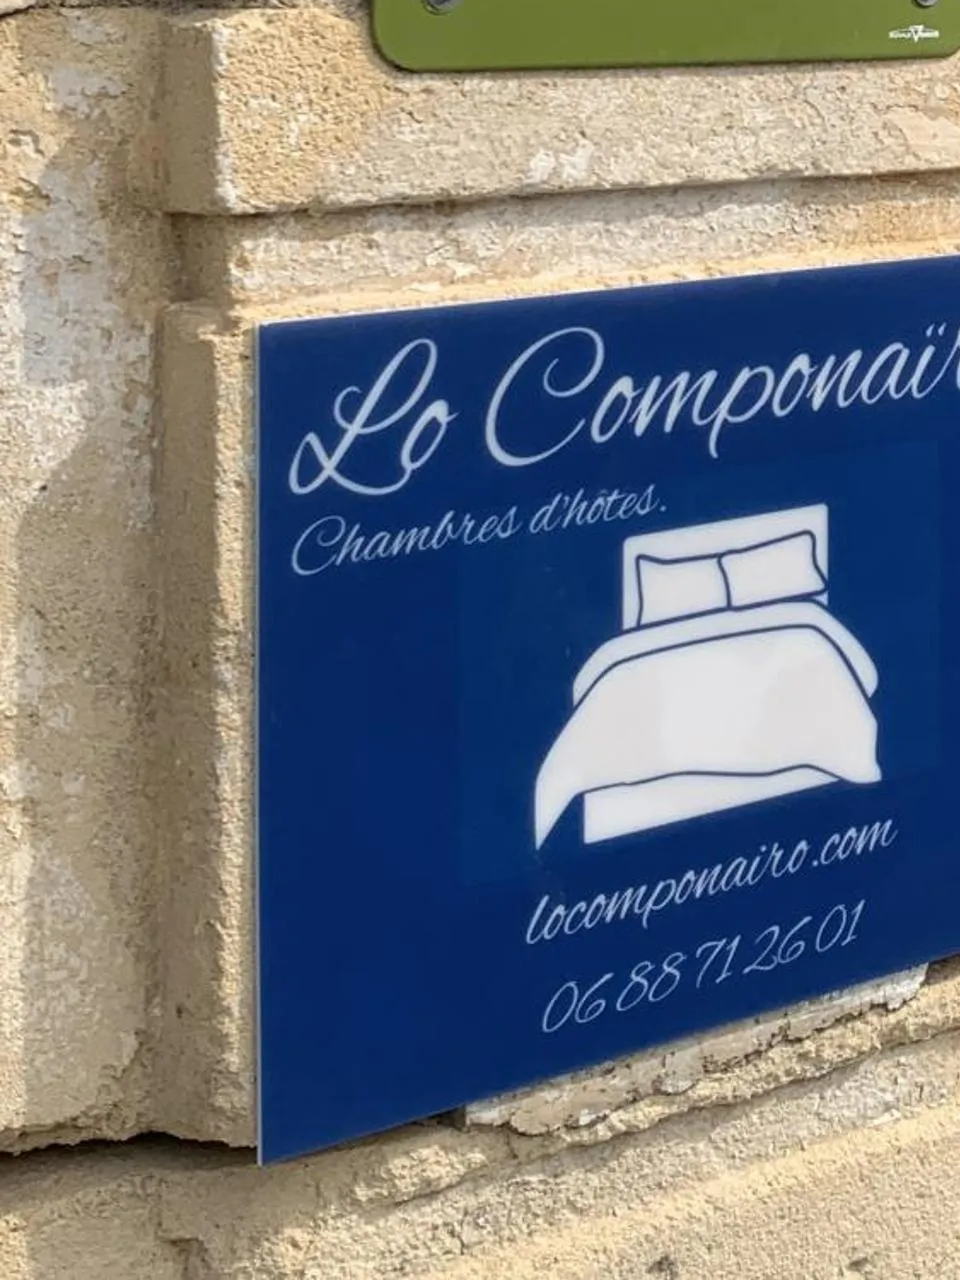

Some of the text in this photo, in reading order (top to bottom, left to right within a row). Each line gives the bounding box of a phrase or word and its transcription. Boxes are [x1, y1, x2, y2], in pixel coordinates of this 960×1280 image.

[288, 337, 457, 495] Lo
[290, 505, 522, 577] Chambres
[526, 819, 898, 944] locomponairo.com
[542, 899, 865, 1033] 06 88 71 26 01
